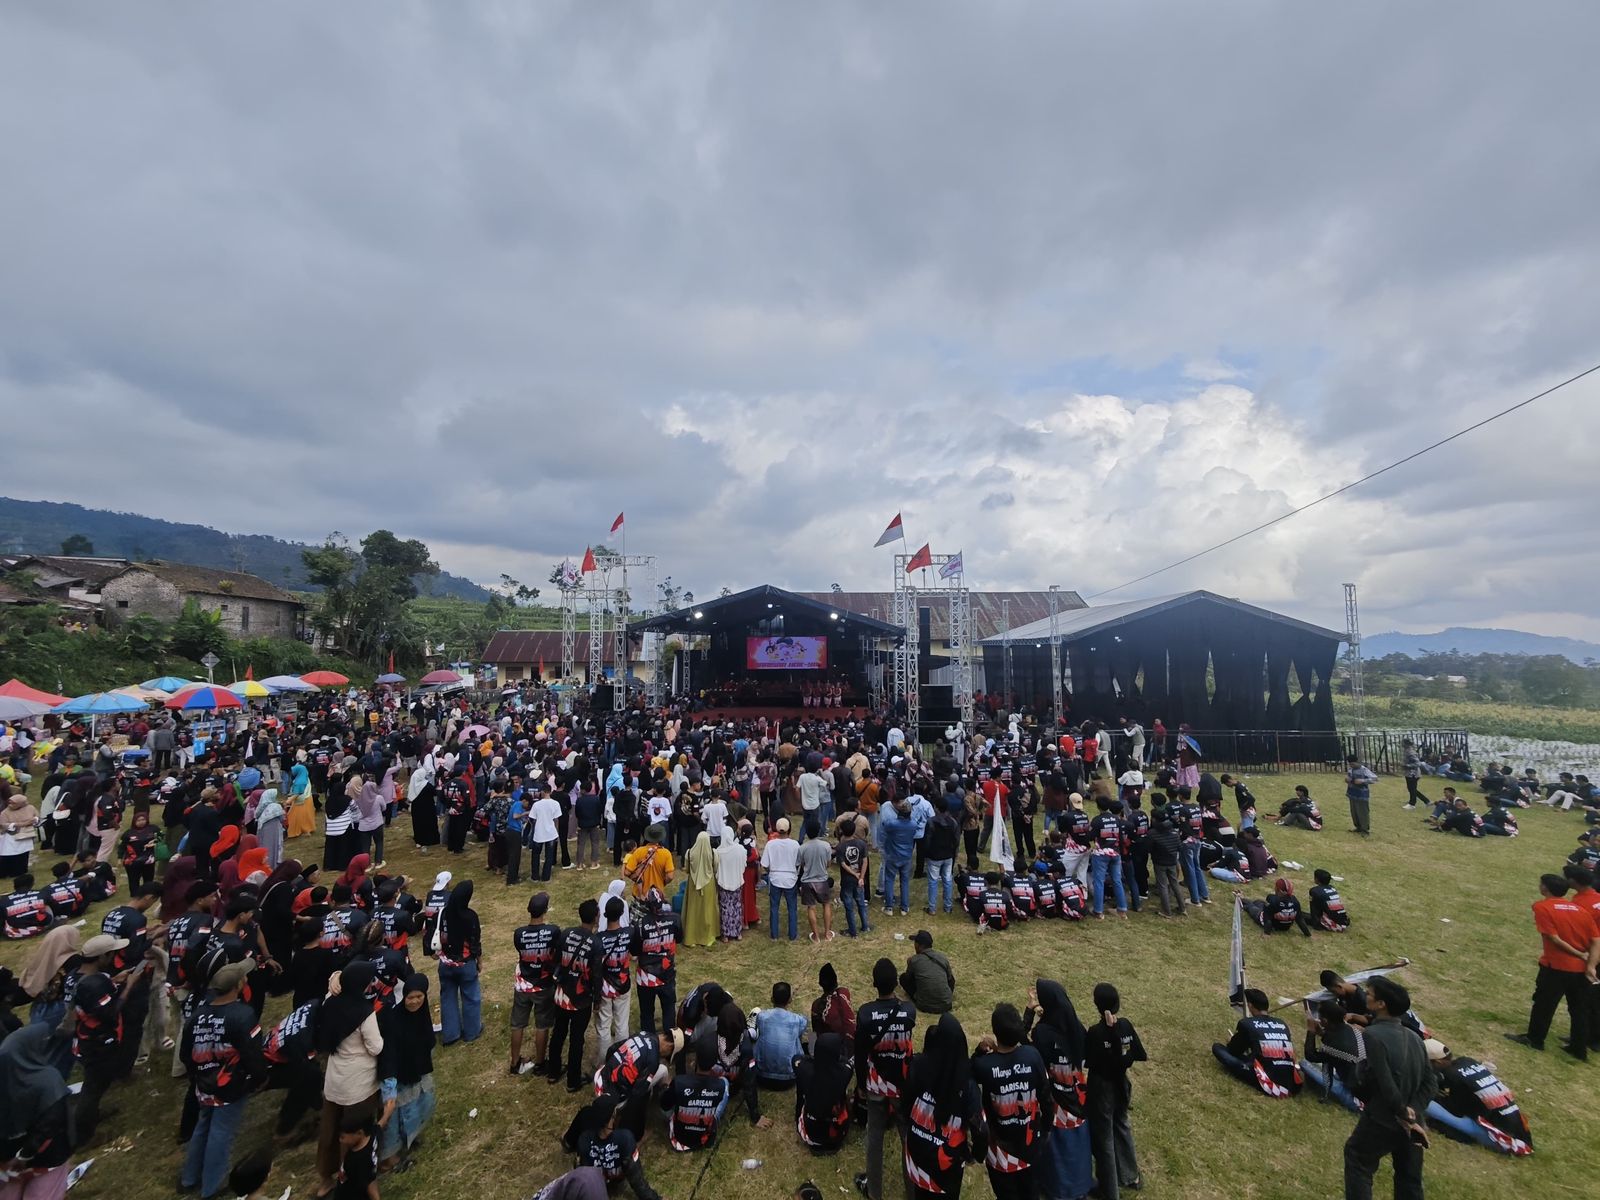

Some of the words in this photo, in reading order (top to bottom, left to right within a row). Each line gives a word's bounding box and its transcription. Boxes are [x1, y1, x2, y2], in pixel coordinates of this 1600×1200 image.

[649, 928, 669, 938] BARAN
[871, 1011, 889, 1021] Margo
[991, 1066, 1011, 1079] Margo
[1013, 1063, 1032, 1074] Rukun
[1000, 1081, 1029, 1094] BARISAN
[687, 1099, 713, 1107] BARISAN
